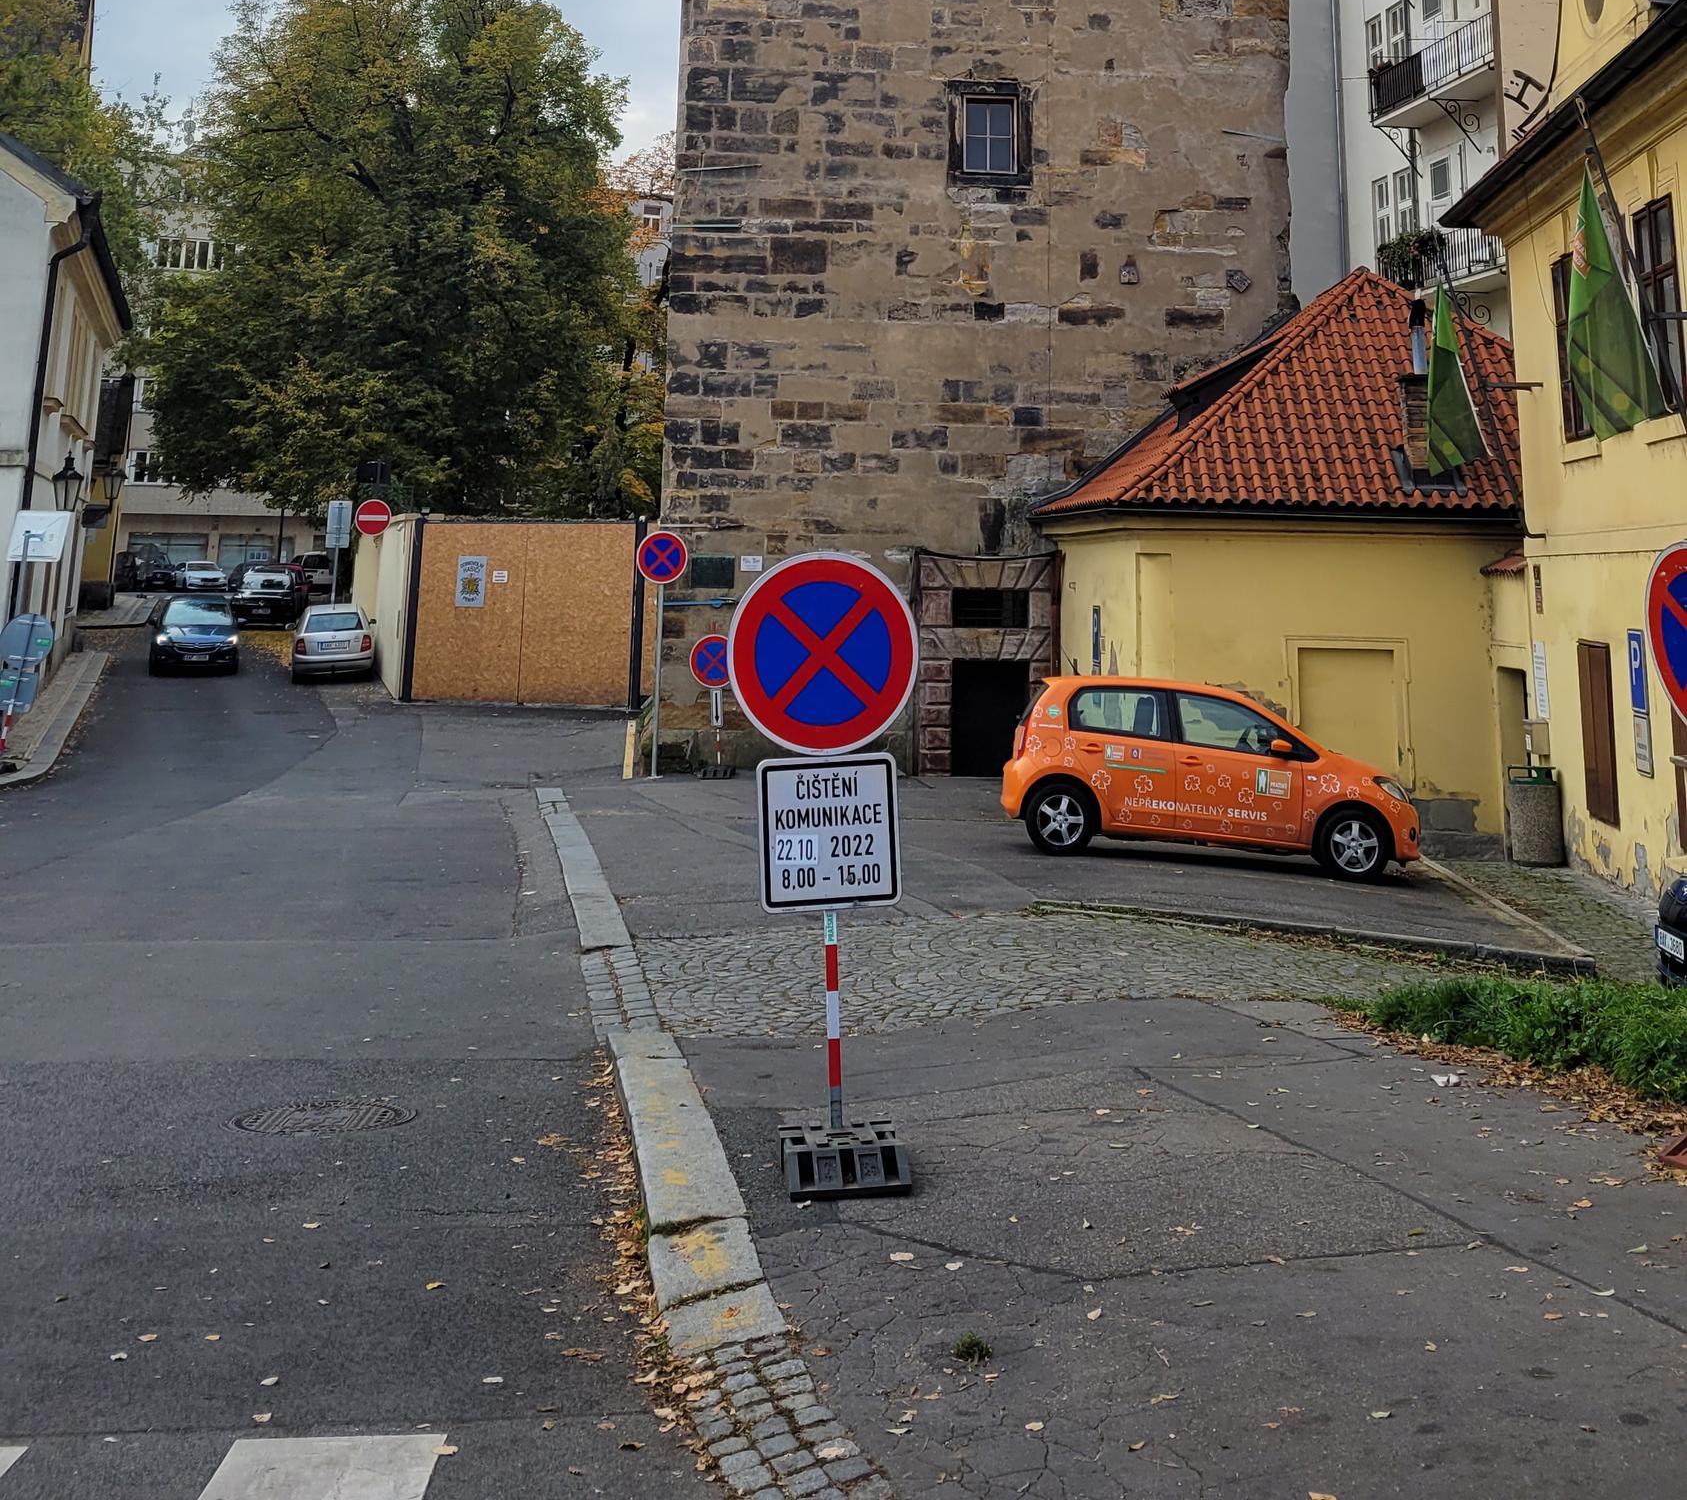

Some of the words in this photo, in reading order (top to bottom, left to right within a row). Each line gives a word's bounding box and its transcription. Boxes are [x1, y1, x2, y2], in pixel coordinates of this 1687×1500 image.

[1630, 640, 1640, 685] P
[796, 770, 858, 800] ČIŠTĚNÍ
[775, 803, 882, 831] KOMUNIKACE
[1124, 796, 1225, 816] NEPŘEKONATELNÝ
[1227, 807, 1268, 821] SERVIS
[777, 838, 817, 861] 22.10.
[830, 833, 874, 858] 2022
[782, 867, 816, 890] 8,00
[837, 863, 881, 886] 15,00
